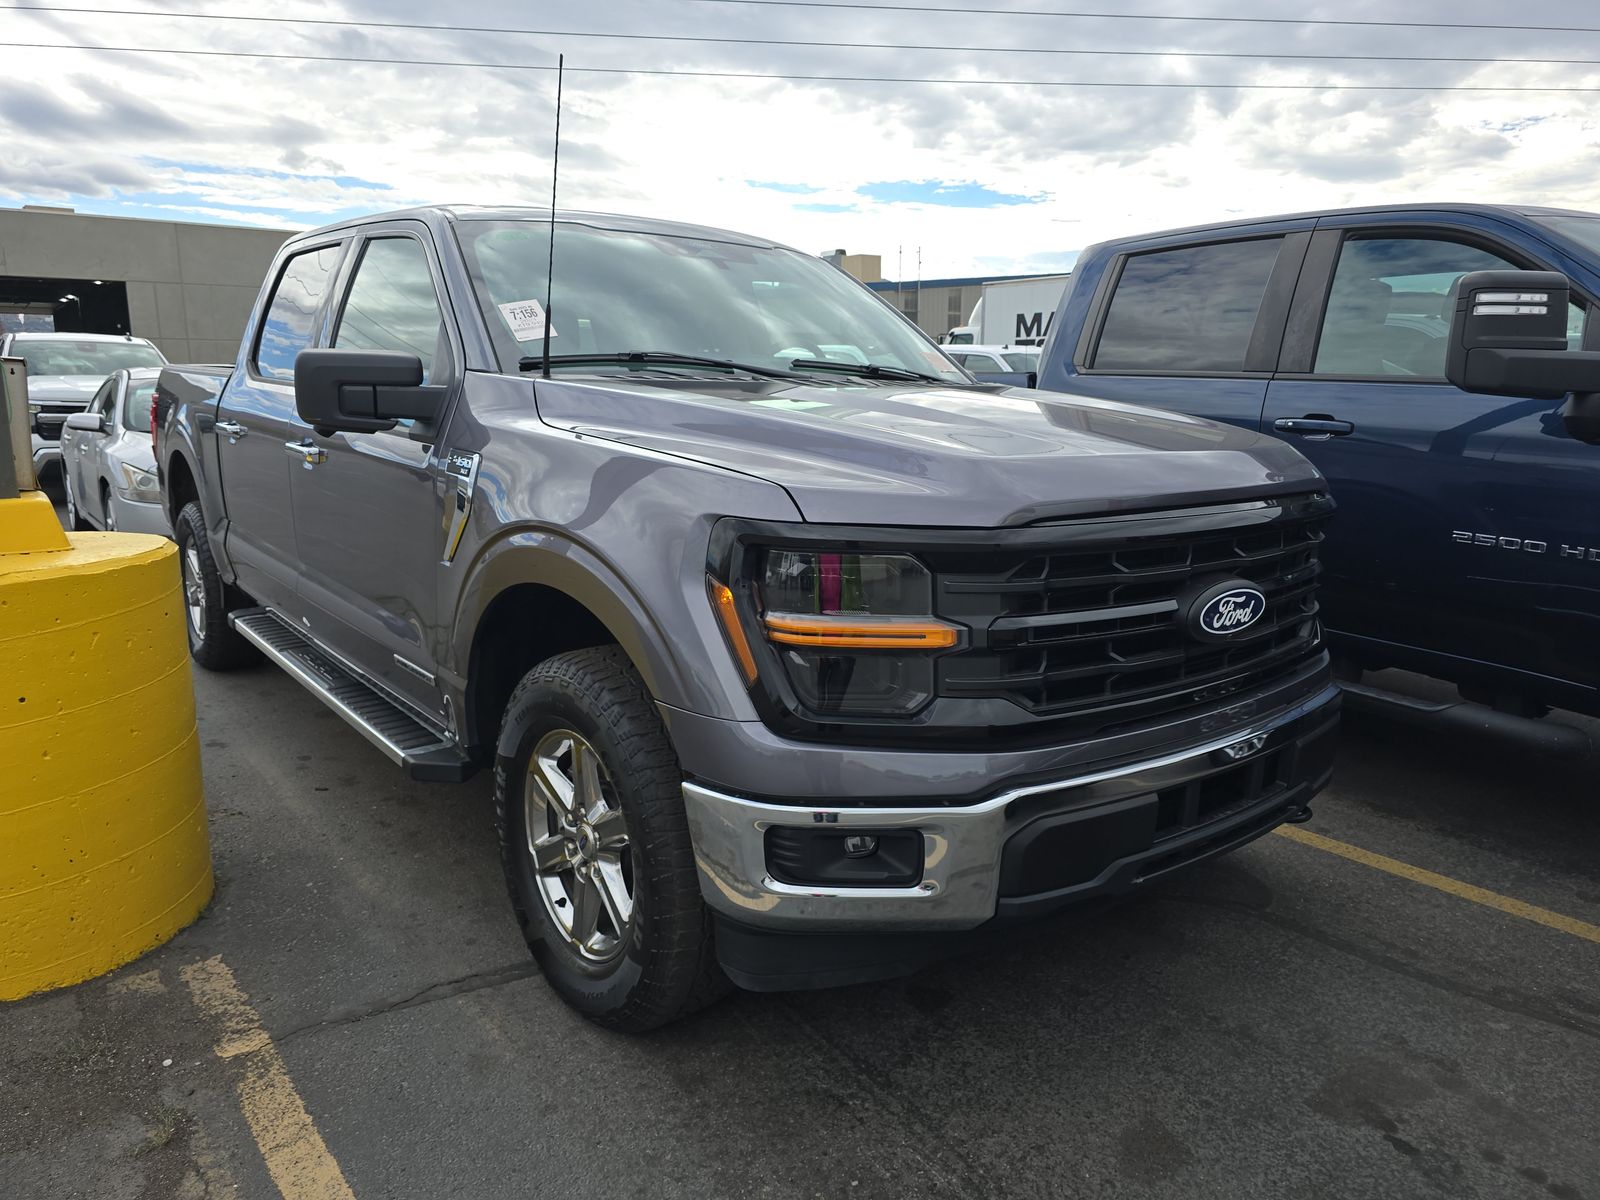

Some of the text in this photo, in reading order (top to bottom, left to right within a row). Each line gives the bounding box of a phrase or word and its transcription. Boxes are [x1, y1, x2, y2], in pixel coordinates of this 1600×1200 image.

[509, 308, 538, 320] 7:156
[1452, 530, 1547, 553] 2500
[1213, 595, 1255, 628] Ford
